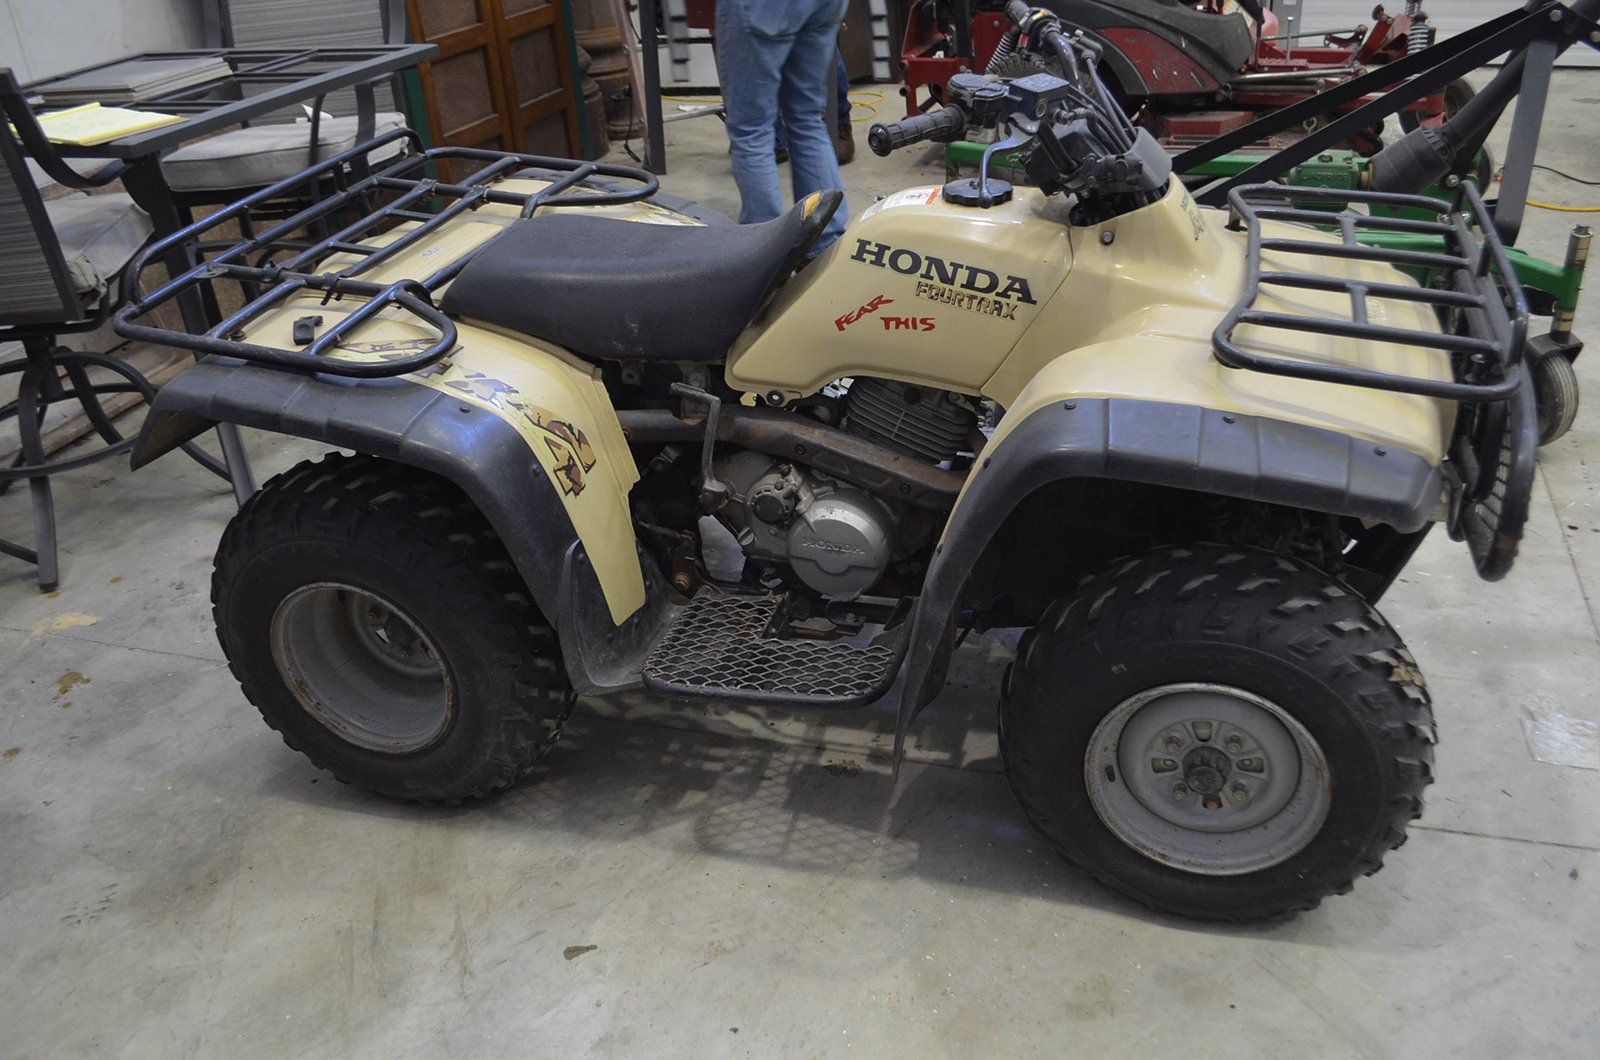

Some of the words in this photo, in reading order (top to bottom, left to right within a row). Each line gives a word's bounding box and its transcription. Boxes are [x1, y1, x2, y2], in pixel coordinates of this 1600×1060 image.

[851, 238, 1037, 305] HONDA
[834, 294, 894, 332] FEAR
[880, 316, 936, 332] THIS
[915, 280, 1020, 321] FOURTRAX
[801, 538, 866, 555] HONDA
